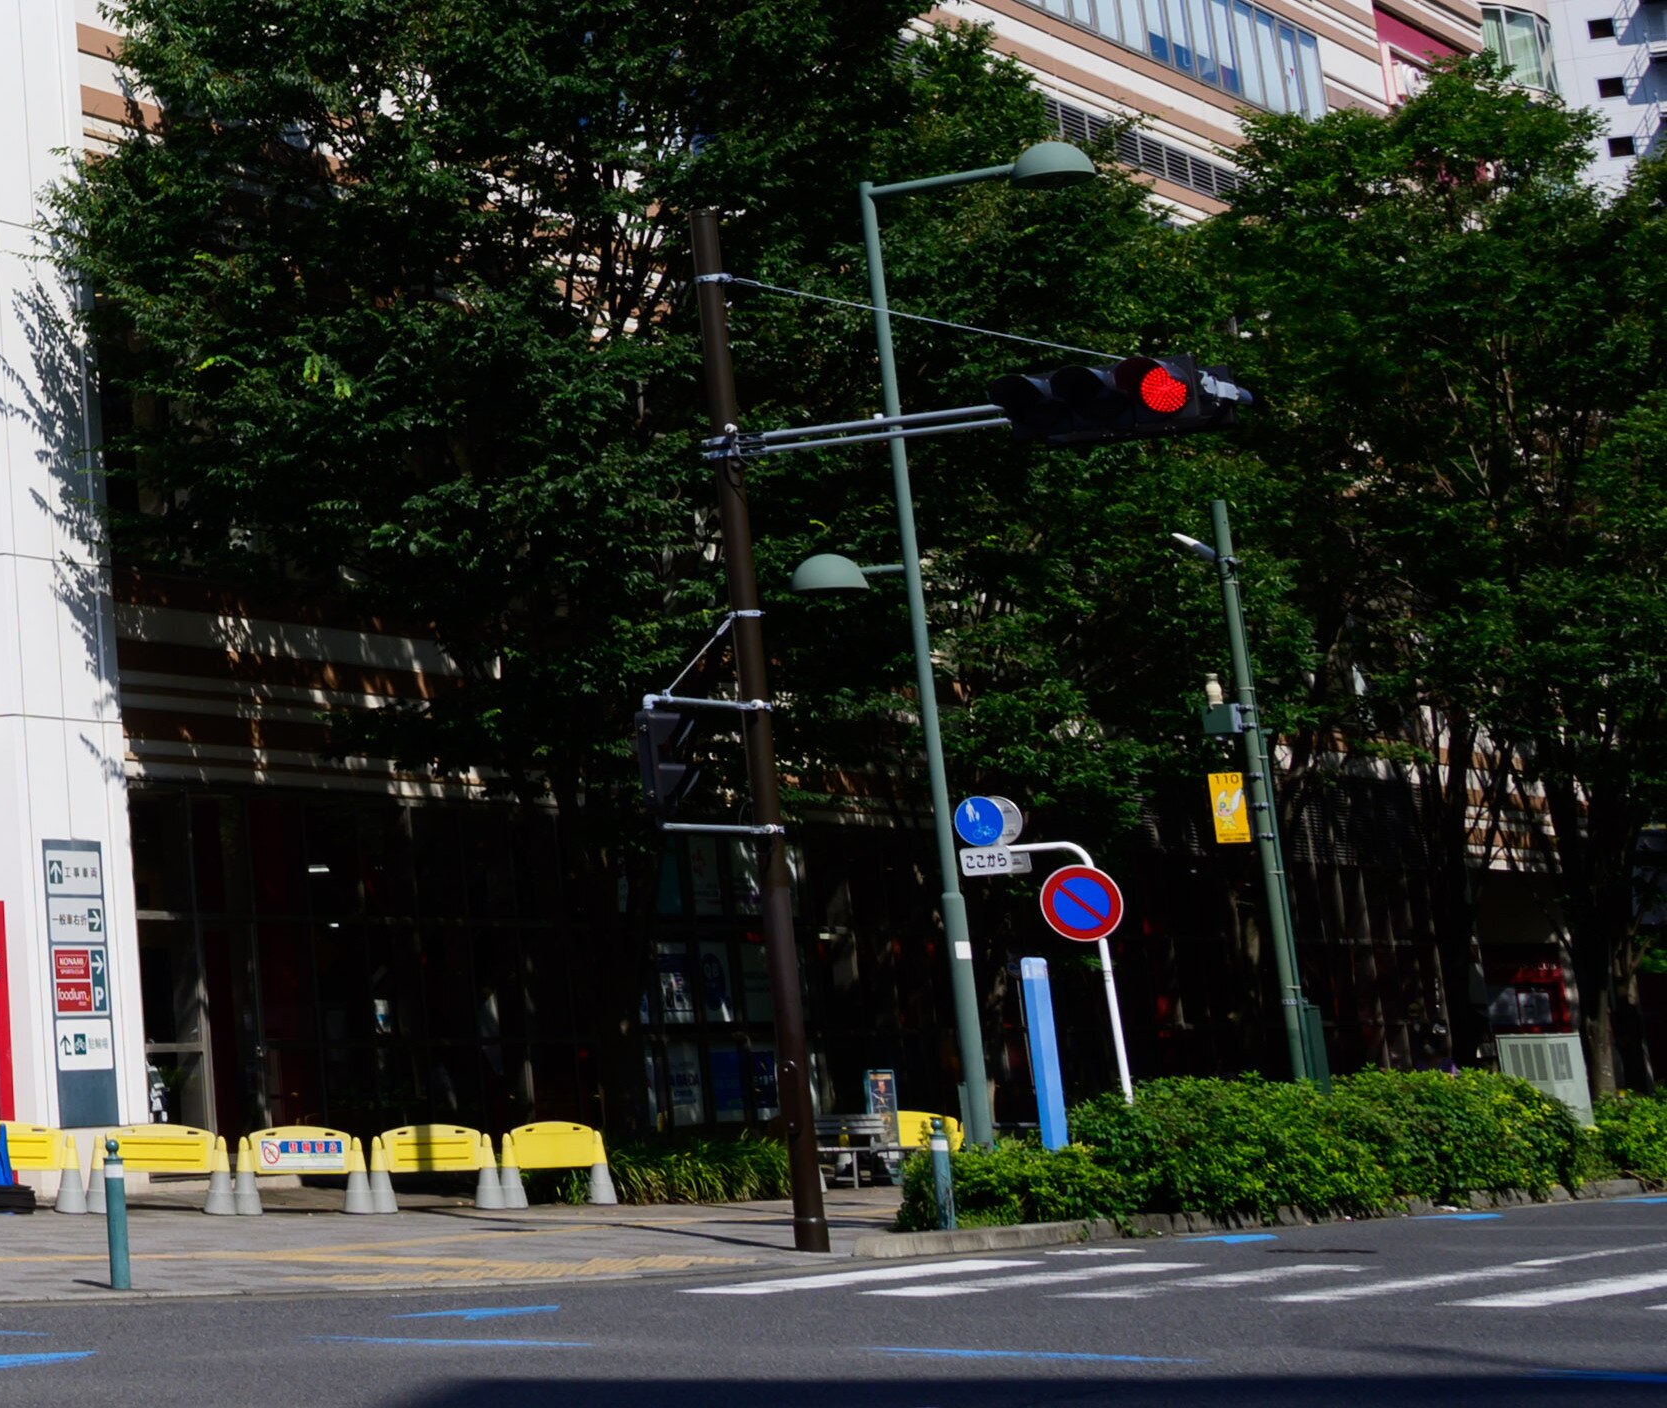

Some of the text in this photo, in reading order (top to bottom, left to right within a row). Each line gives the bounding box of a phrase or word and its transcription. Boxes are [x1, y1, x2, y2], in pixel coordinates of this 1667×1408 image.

[1215, 774, 1239, 785] 110
[966, 852, 1008, 869] ここから
[59, 957, 84, 966] KONAMI
[58, 988, 86, 1001] foodium
[95, 986, 104, 1007] P
